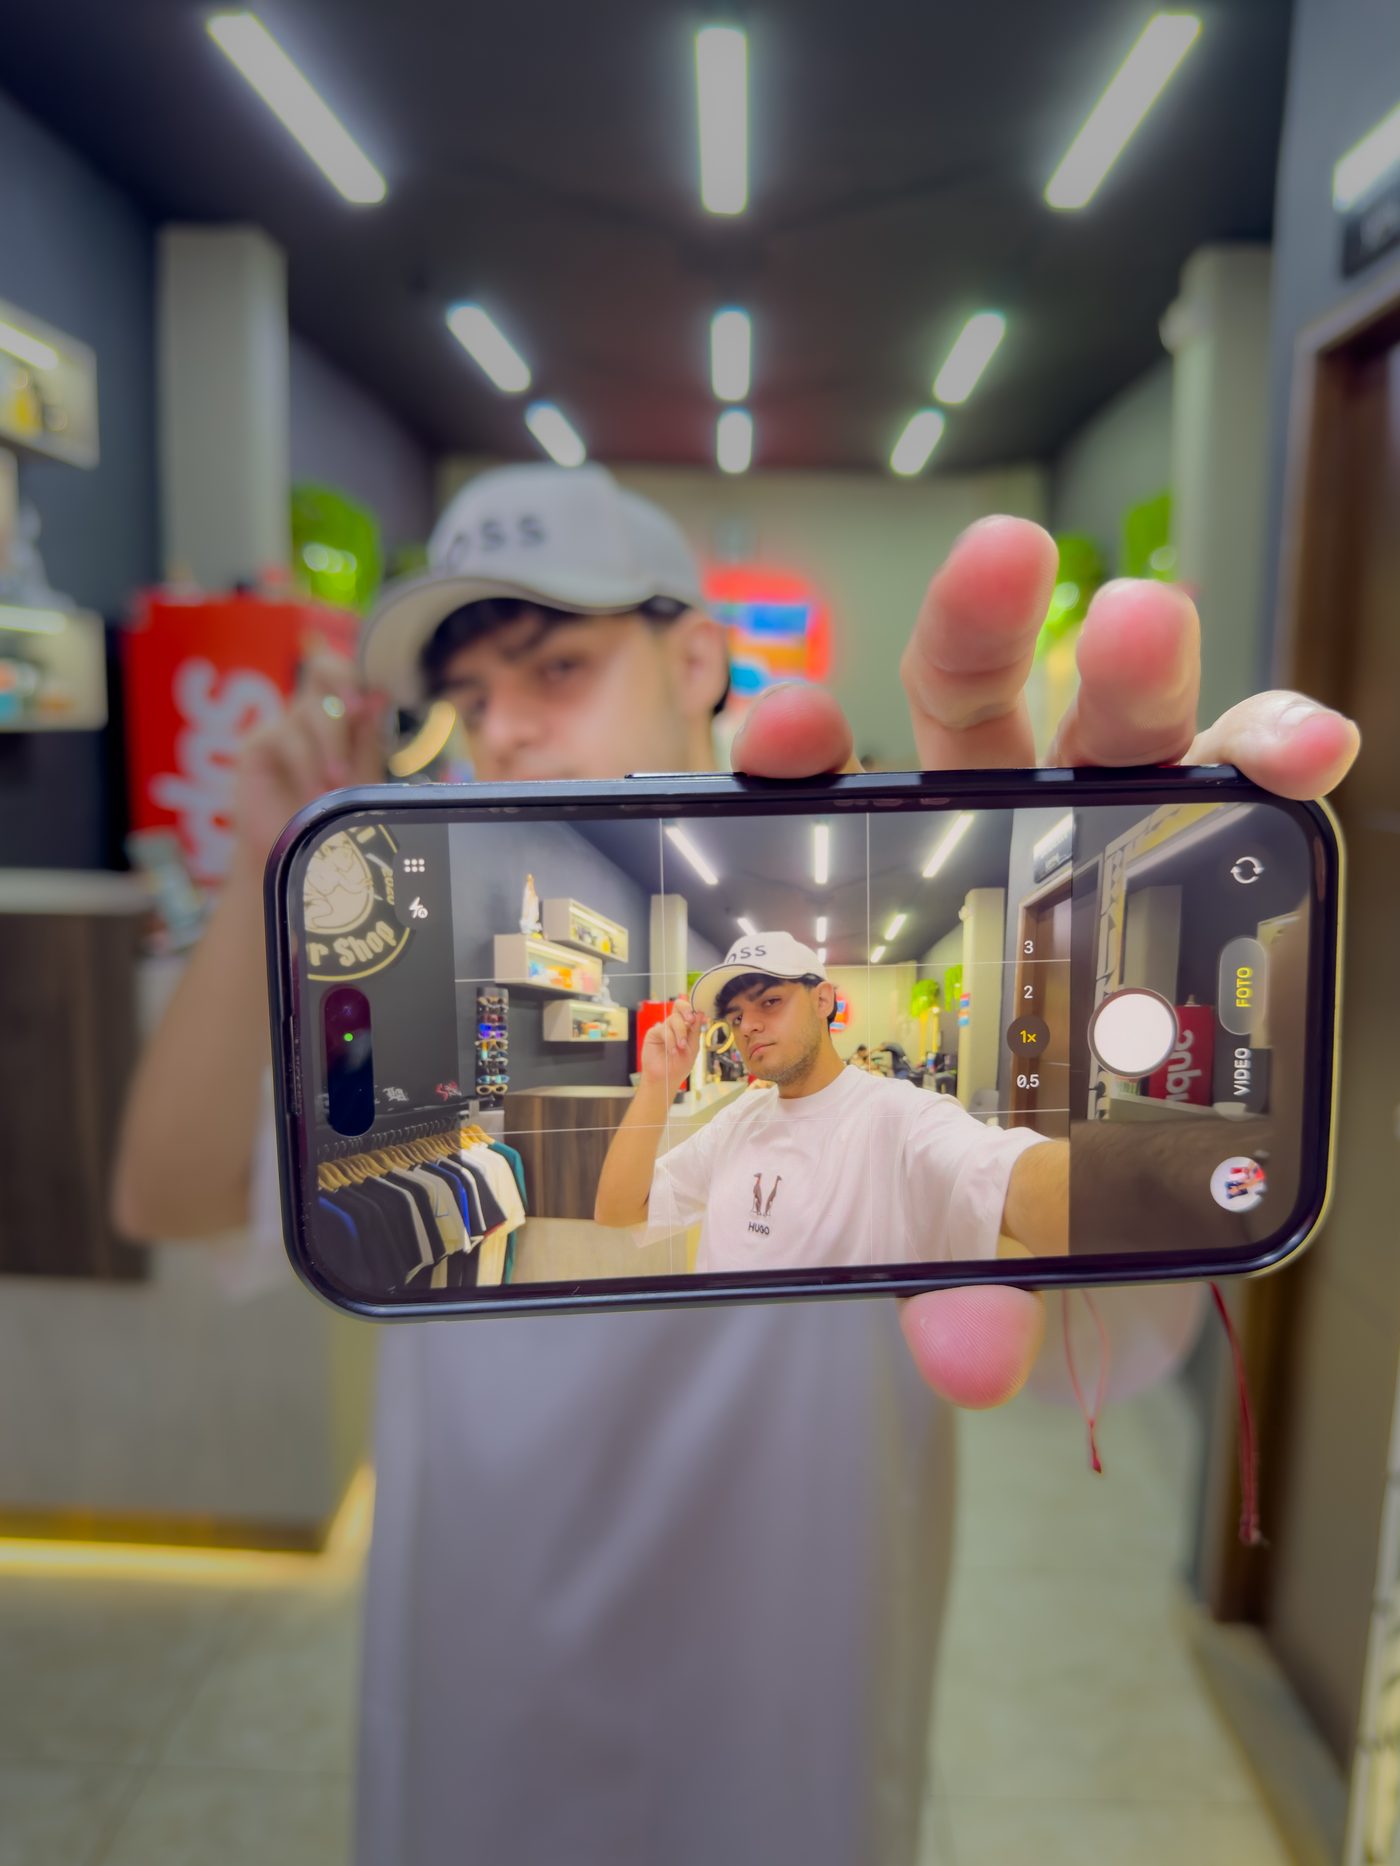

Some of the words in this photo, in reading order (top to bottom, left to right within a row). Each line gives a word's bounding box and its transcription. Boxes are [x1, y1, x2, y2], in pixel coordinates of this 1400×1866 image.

[333, 920, 397, 967] Shop
[1024, 940, 1034, 954] 3
[1023, 985, 1034, 999] 2
[1235, 966, 1253, 1008] FOTO
[1019, 1029, 1037, 1044] 1x
[1233, 1047, 1251, 1096] VIDEO
[1016, 1073, 1040, 1089] 0,5
[748, 1221, 770, 1236] HUGO
